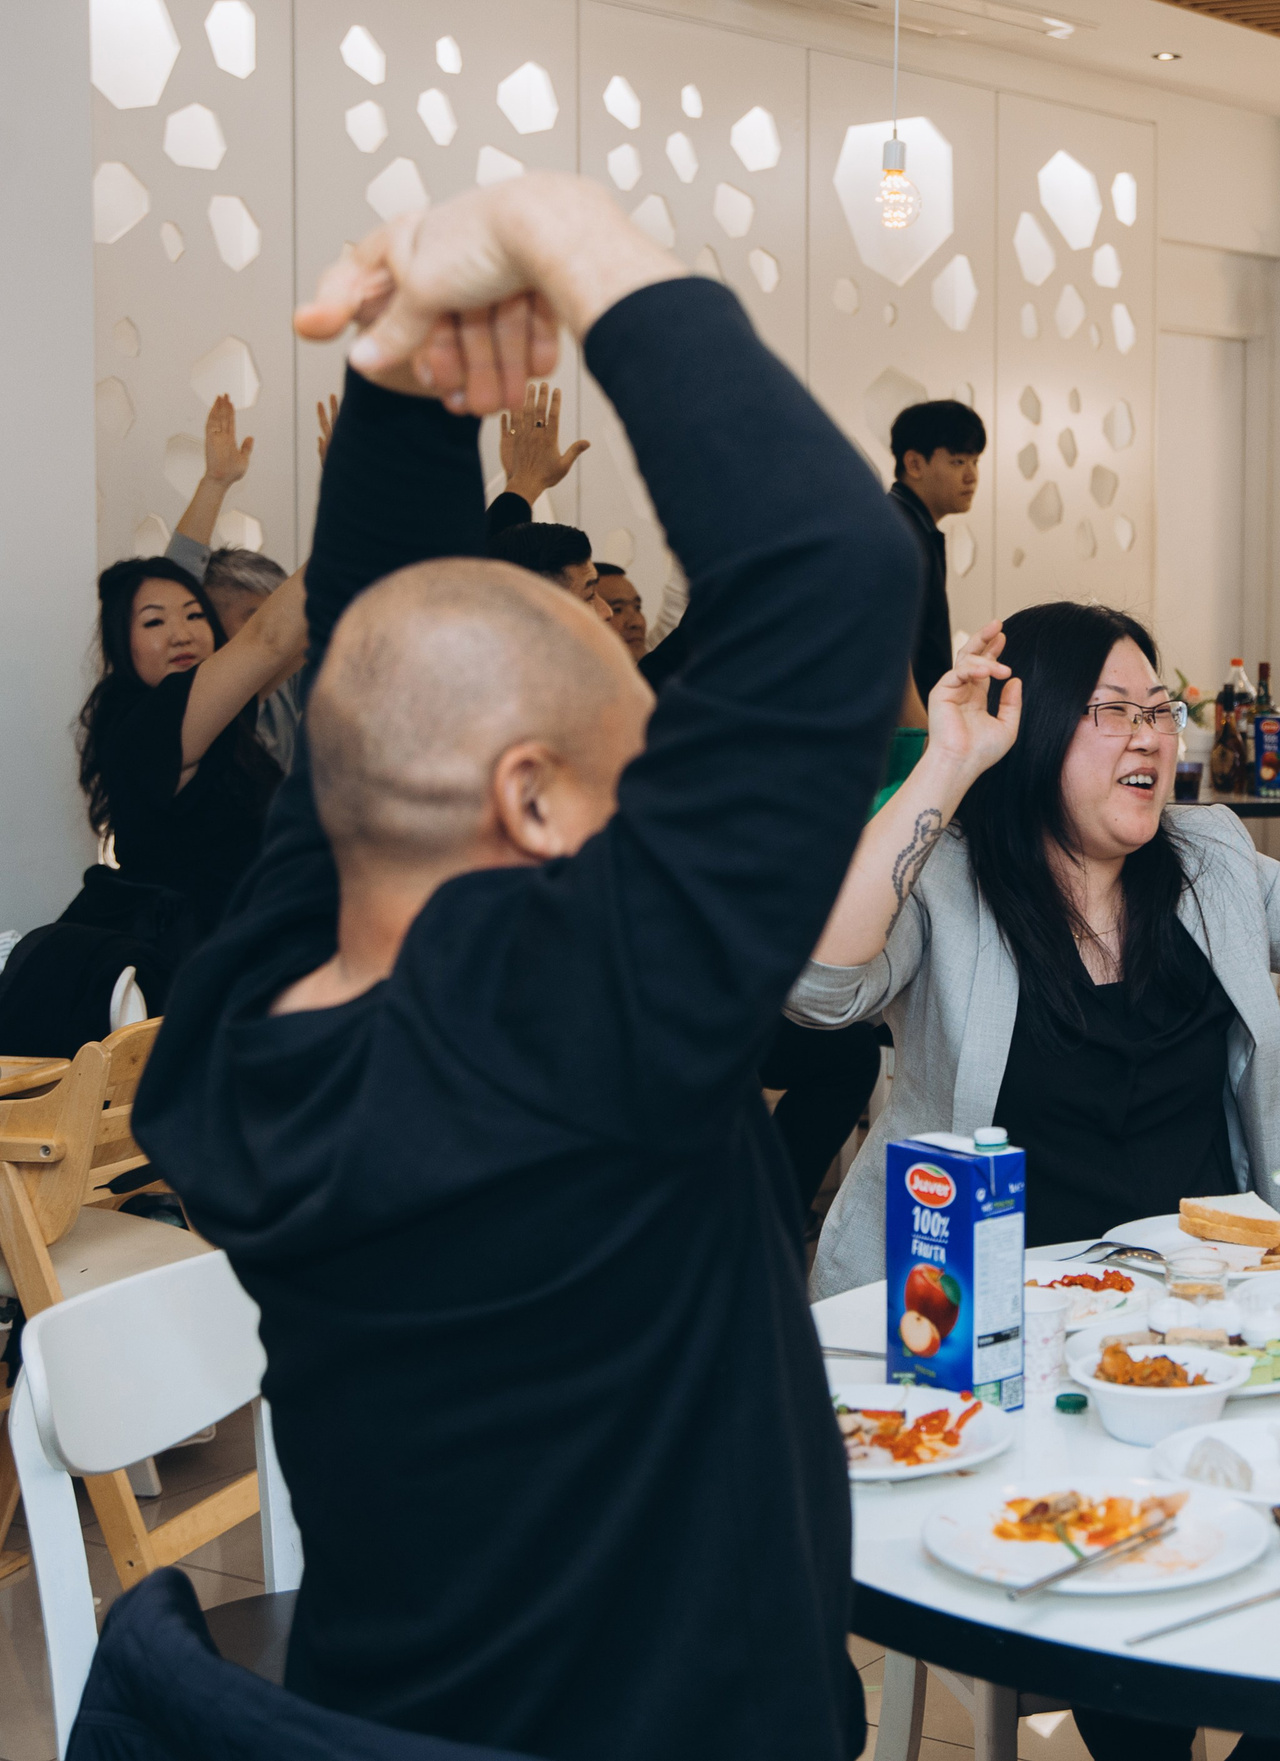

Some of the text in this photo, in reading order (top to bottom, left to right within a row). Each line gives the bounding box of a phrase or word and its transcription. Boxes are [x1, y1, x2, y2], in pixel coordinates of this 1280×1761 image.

[912, 1174, 950, 1198] Juver
[912, 1205, 950, 1238] 100%
[911, 1238, 946, 1264] FRUTA
